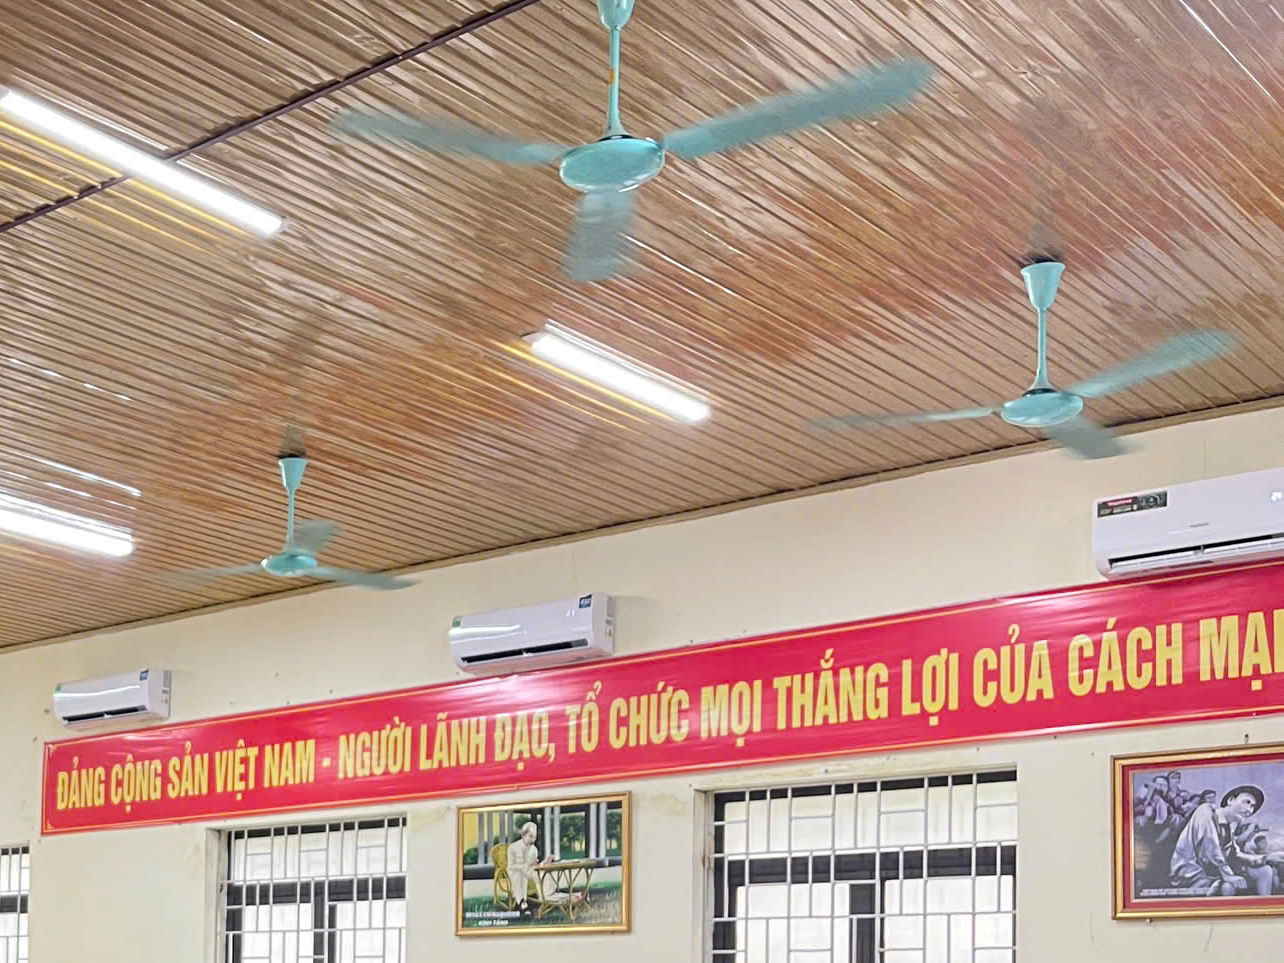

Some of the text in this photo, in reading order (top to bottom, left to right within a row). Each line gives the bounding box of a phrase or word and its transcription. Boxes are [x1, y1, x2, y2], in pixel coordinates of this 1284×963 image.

[56, 756, 105, 810] ĐẢNG
[110, 753, 162, 812] CỘNG
[167, 741, 209, 798] SẢN
[214, 739, 259, 800] VIỆT
[264, 738, 316, 788] NAM
[322, 757, 331, 768] -
[338, 715, 411, 779] NGƯỜI
[419, 711, 486, 770] LÃNH
[494, 709, 556, 771] ĐẠO,
[566, 680, 602, 754] TỔ
[609, 681, 690, 750] CHỨC
[700, 679, 762, 747] MỌI
[773, 648, 888, 731] THẮNG
[901, 647, 959, 726] LỢI
[972, 623, 1054, 708] CỦA
[1068, 618, 1183, 697] CÁCH
